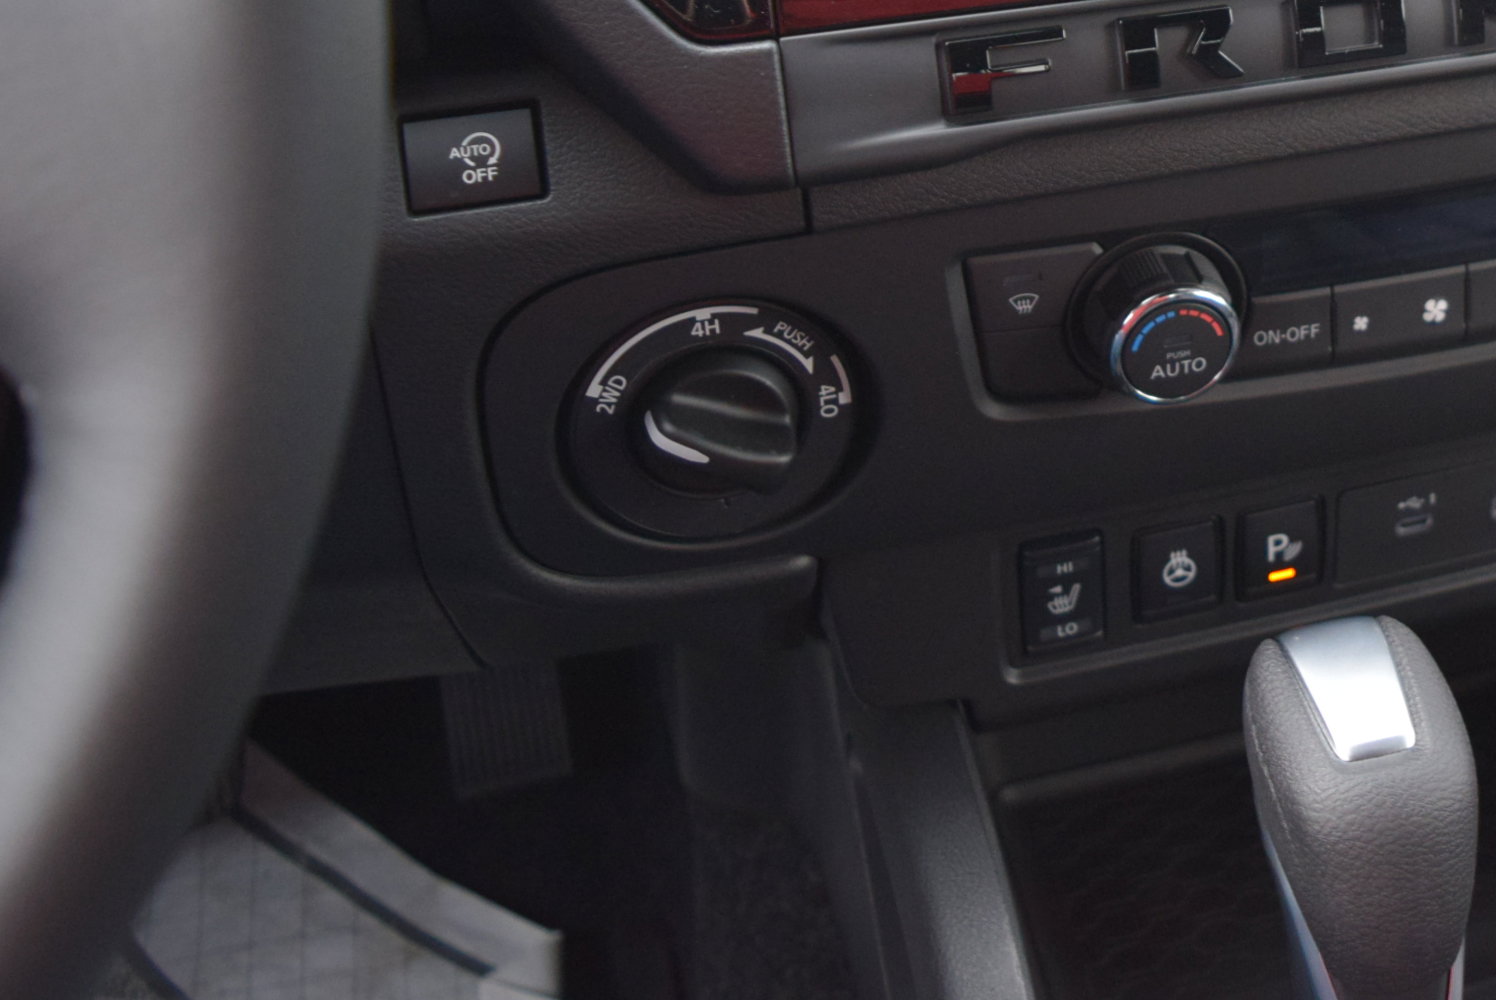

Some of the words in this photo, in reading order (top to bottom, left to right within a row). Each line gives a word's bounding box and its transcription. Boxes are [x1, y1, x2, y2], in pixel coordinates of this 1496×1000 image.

[449, 143, 491, 159] AUTO
[462, 166, 499, 184] OFF
[690, 318, 721, 339] 4H
[773, 320, 816, 351] PUSH
[1253, 322, 1321, 347] ON-OFF
[1166, 349, 1191, 360] PUSH
[1150, 356, 1207, 380] AUTO
[595, 374, 629, 416] 2WD
[817, 383, 839, 419] 4LO
[1056, 561, 1074, 575] HI
[1057, 621, 1079, 638] LO
